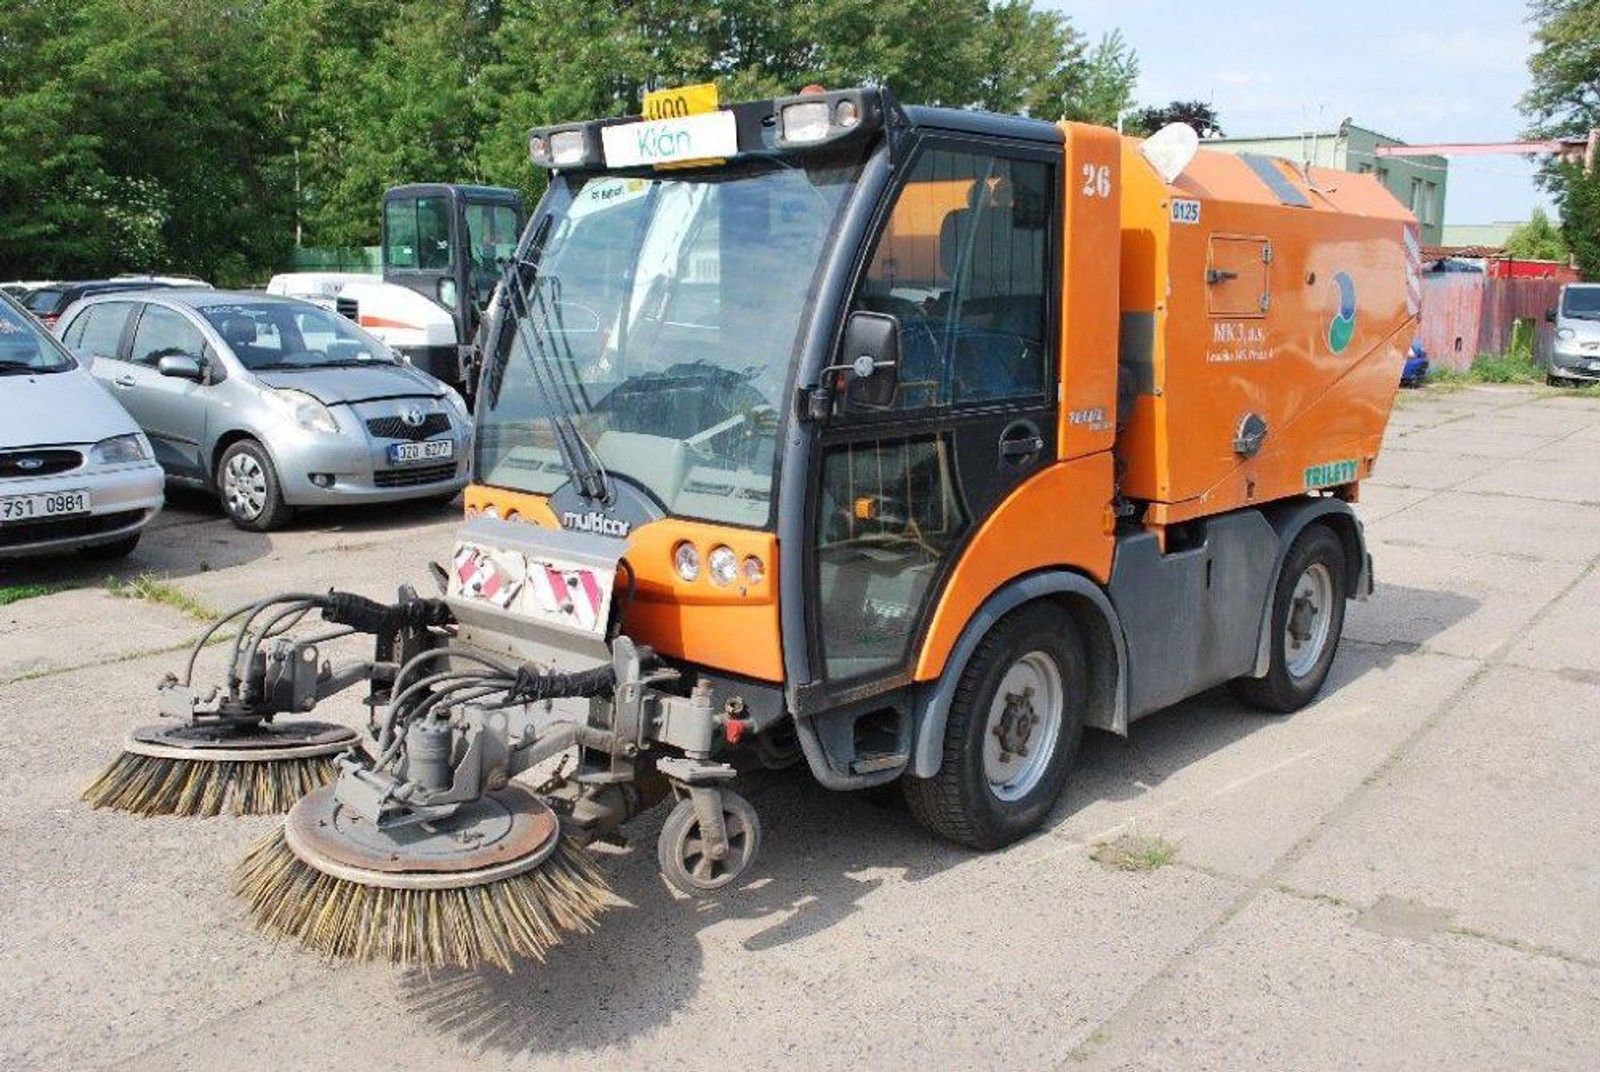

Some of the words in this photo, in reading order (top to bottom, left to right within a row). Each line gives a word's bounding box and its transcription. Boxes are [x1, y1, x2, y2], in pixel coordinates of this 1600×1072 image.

[1082, 163, 1112, 199] 26
[1172, 202, 1199, 221] 0125
[1213, 322, 1236, 343] MK
[3, 499, 35, 518] 7S1
[46, 494, 84, 513] 0981
